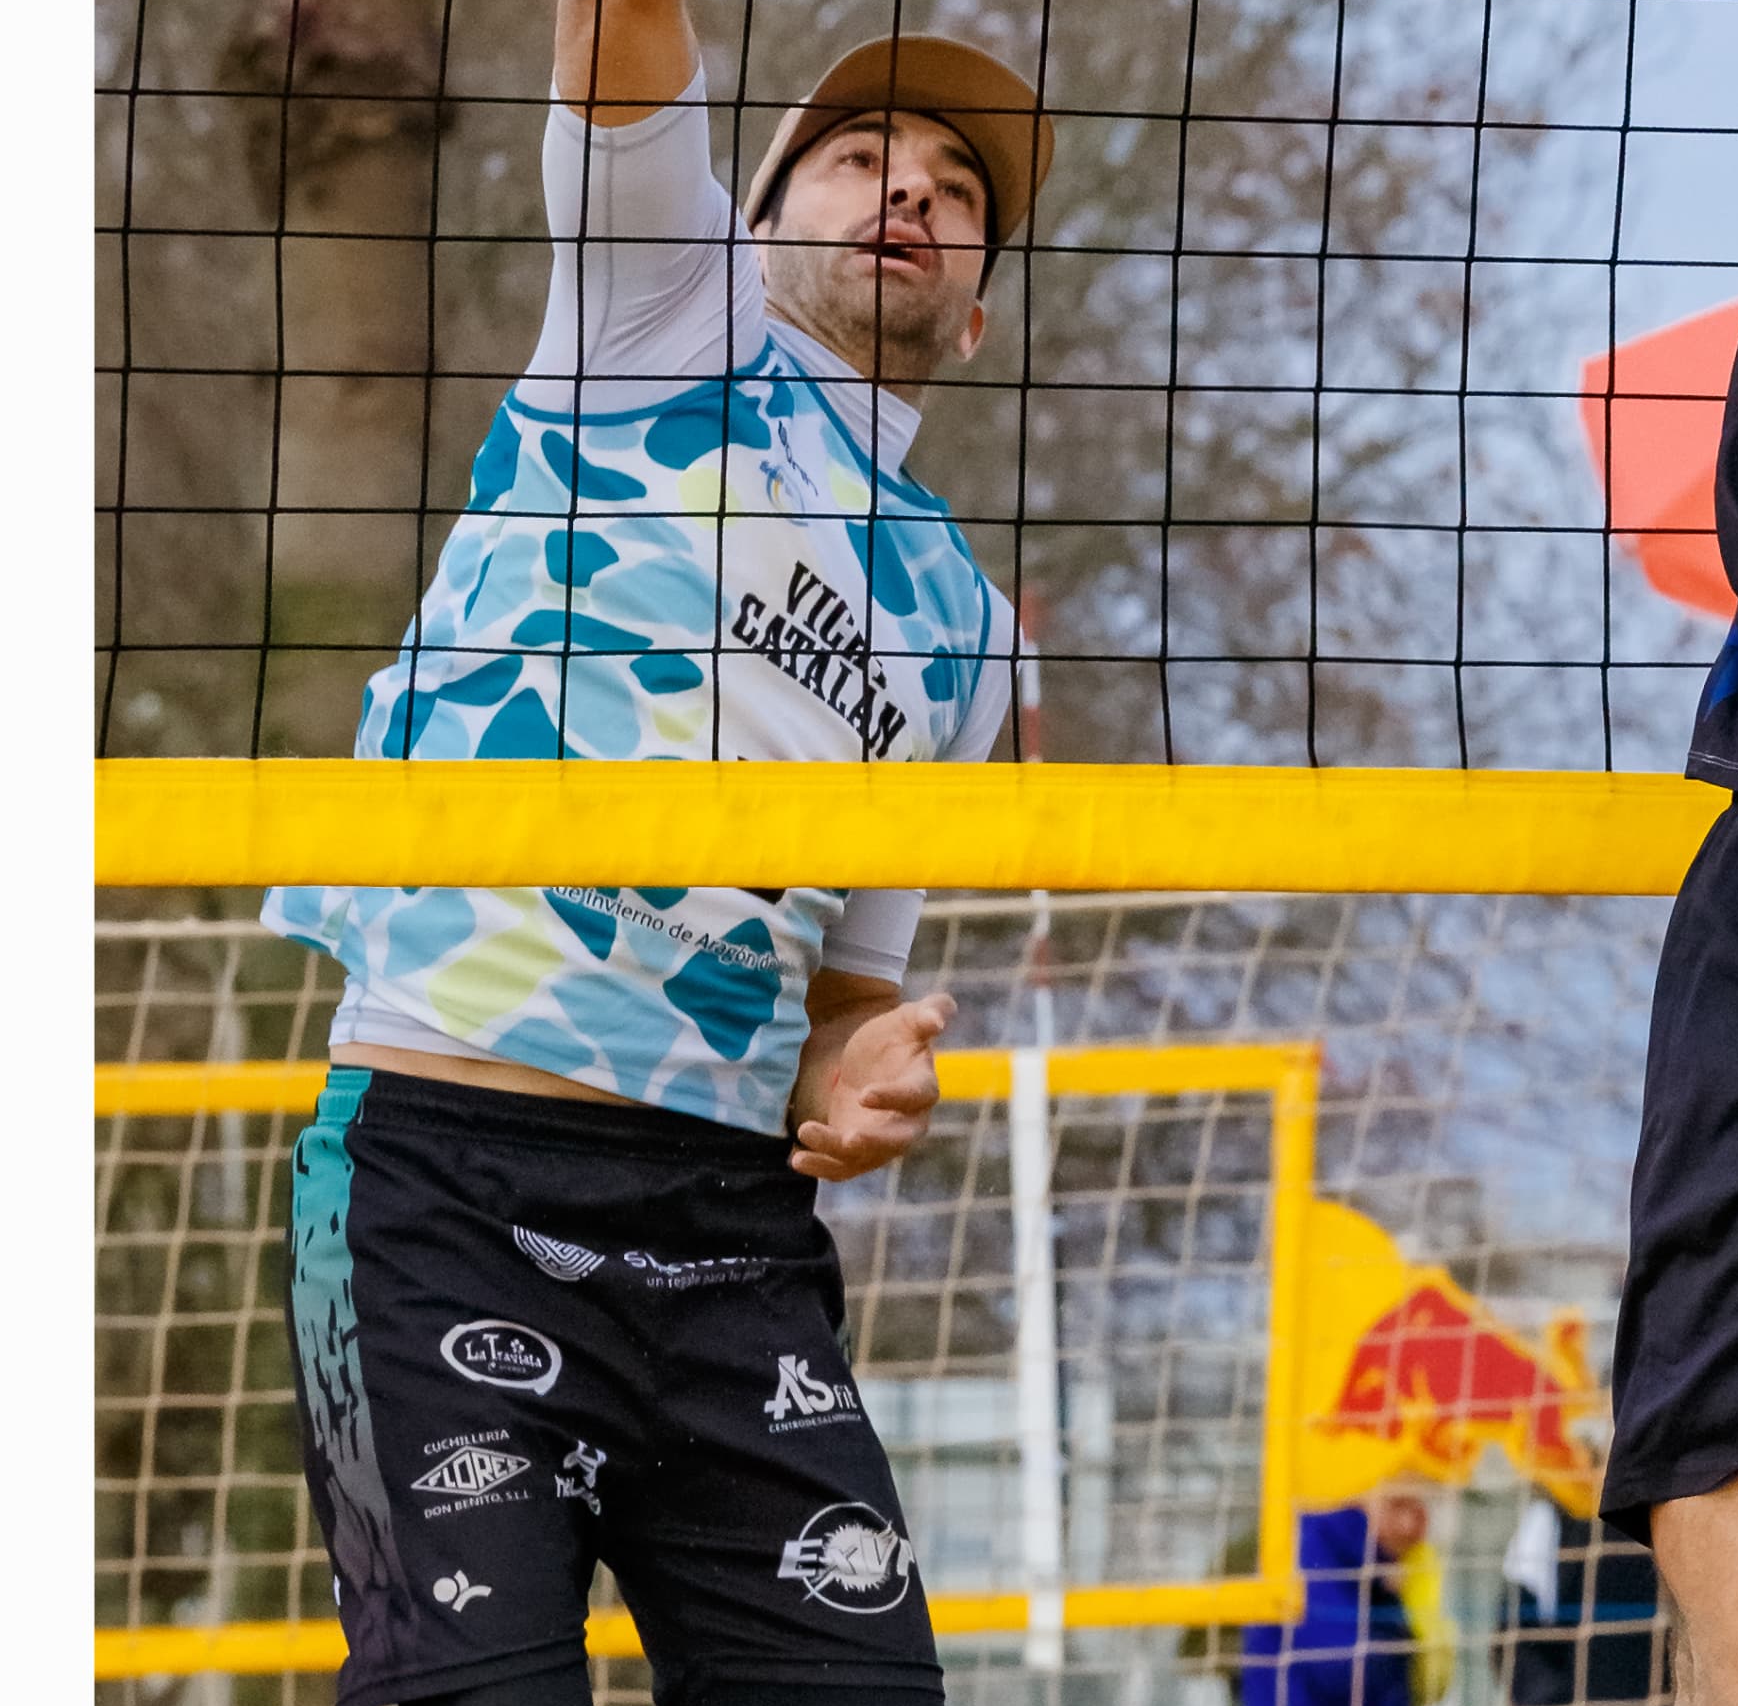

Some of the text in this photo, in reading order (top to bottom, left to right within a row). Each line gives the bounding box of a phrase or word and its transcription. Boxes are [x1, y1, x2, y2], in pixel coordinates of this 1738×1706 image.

[584, 887, 664, 932] invierno
[669, 923, 693, 943] de
[424, 1503, 452, 1519] DON
